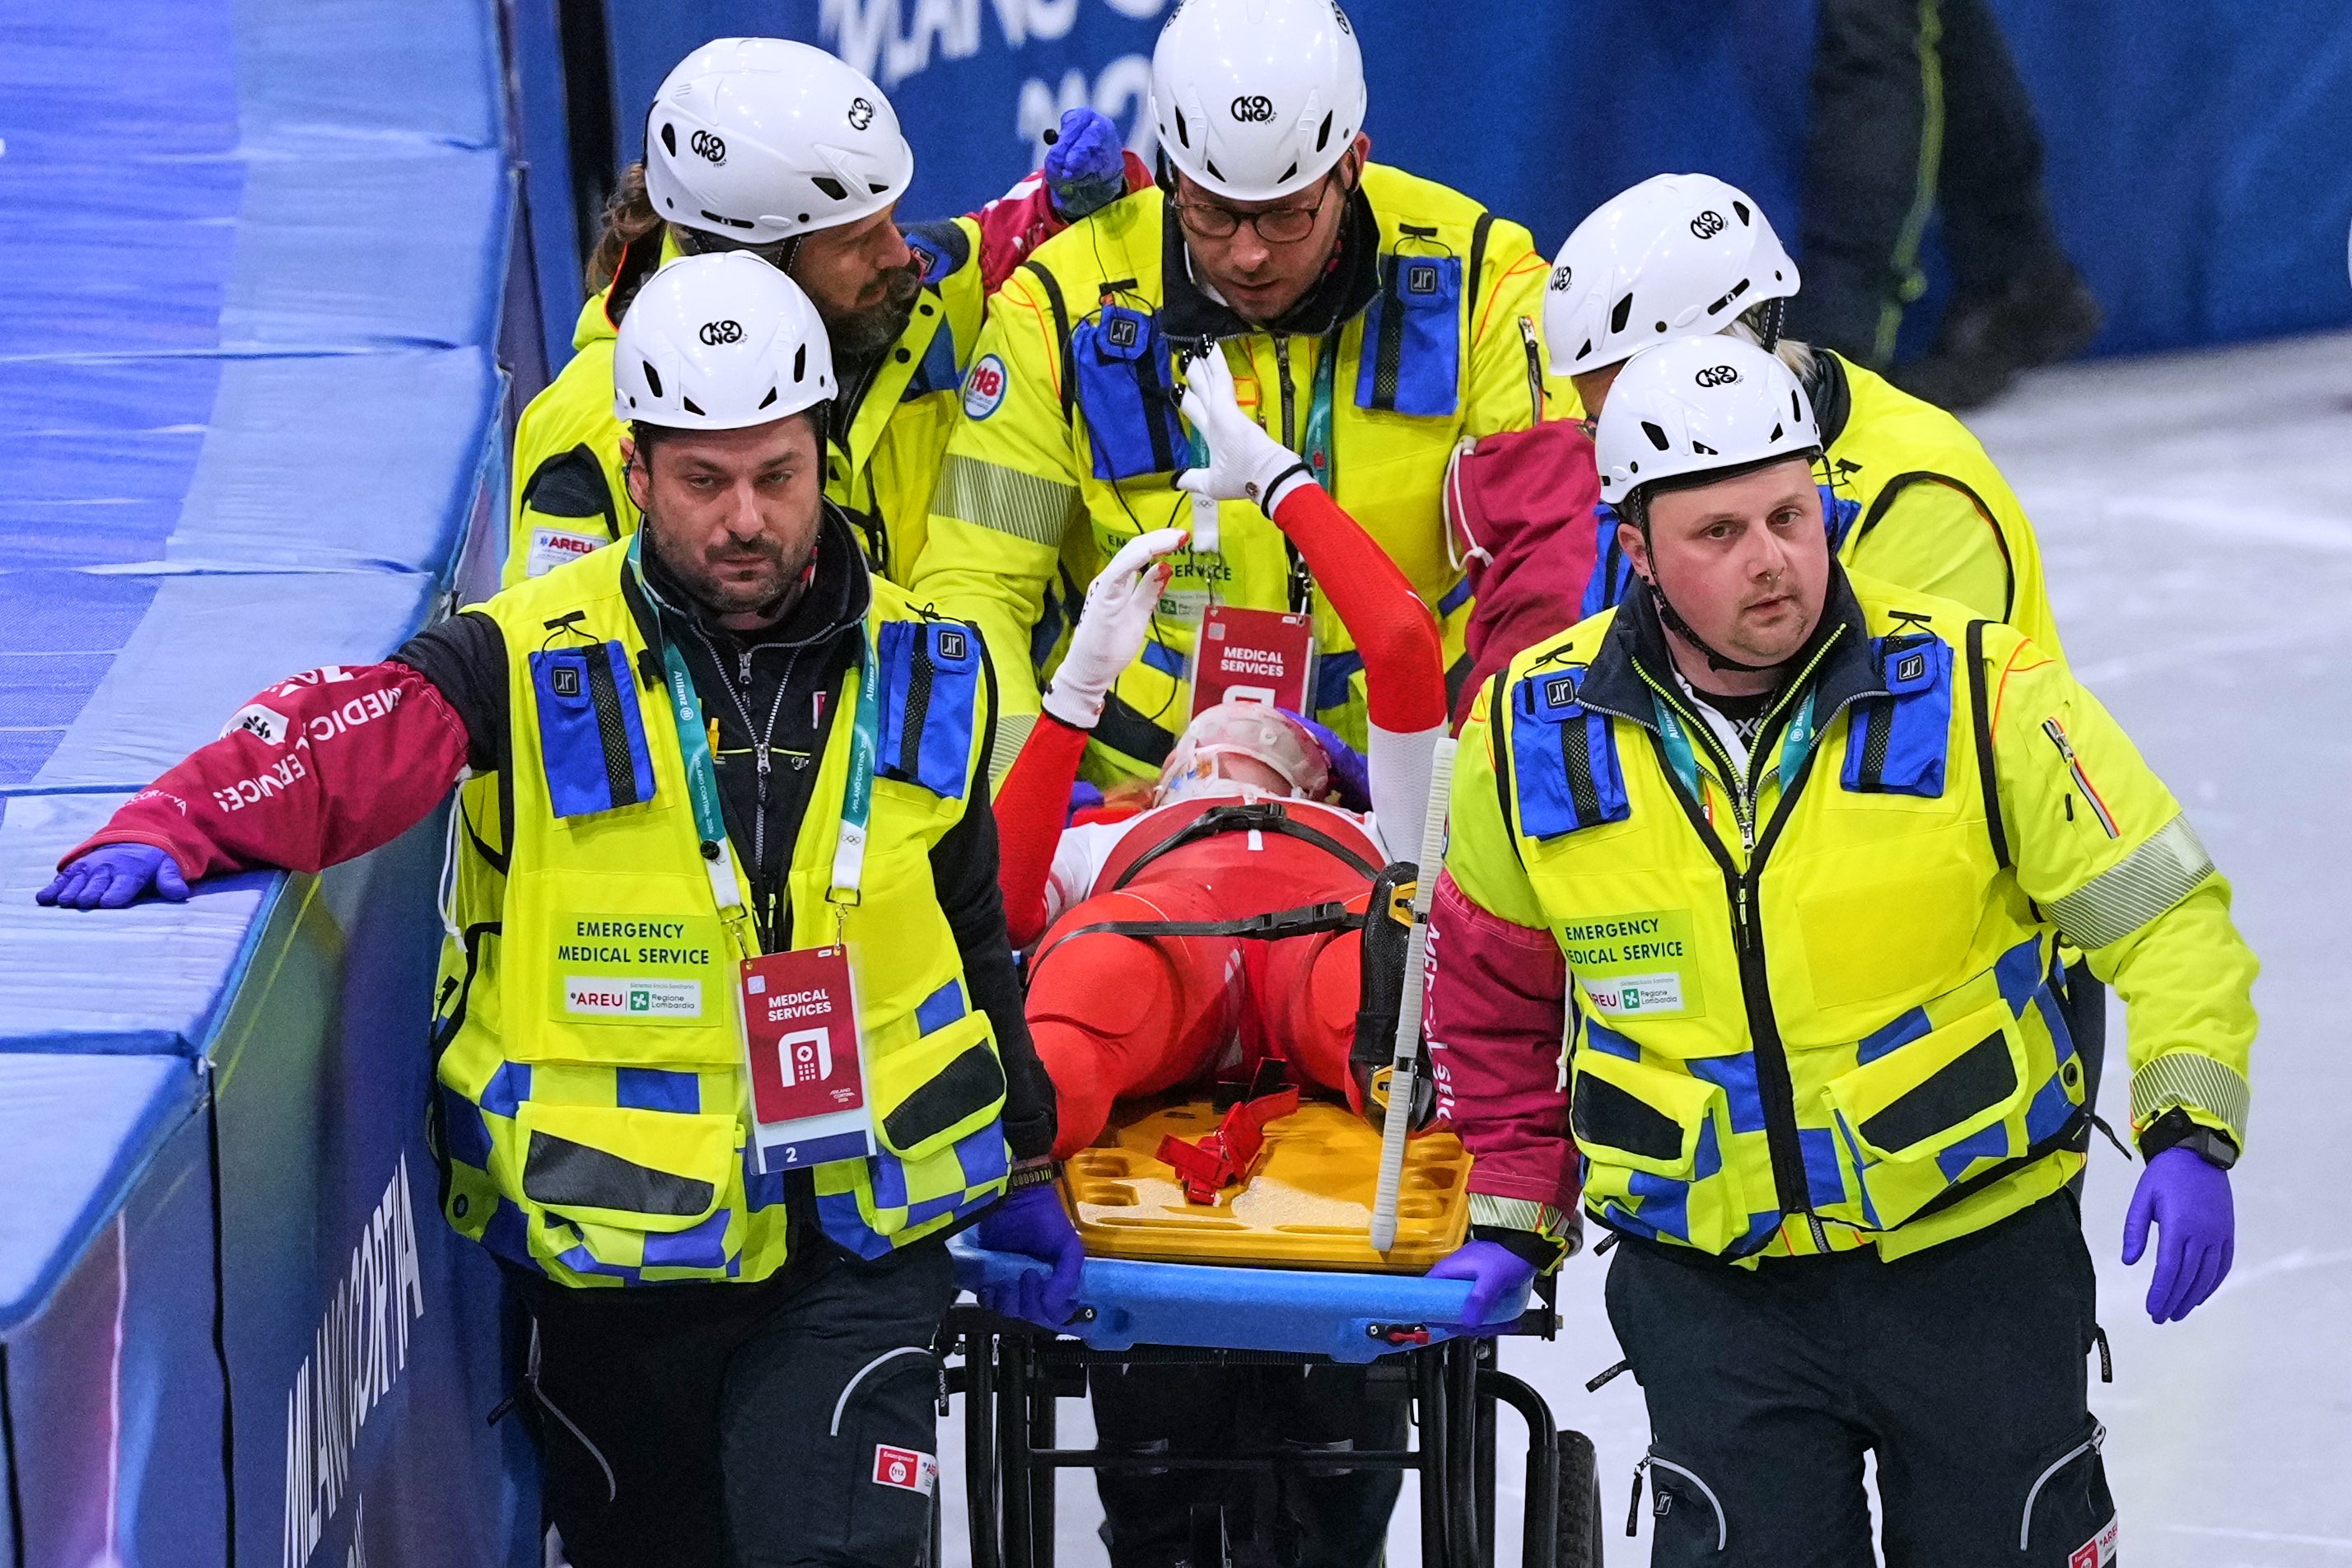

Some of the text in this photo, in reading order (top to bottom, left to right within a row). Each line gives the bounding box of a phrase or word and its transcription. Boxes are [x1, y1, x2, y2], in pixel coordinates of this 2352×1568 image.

[971, 366, 1000, 396] 118
[548, 537, 593, 553] AREU
[1175, 563, 1232, 581] ERVICE
[1223, 646, 1285, 665] MEDICAL
[1220, 659, 1285, 678] SERVICES
[674, 670, 688, 707] Allianz
[577, 922, 684, 939] EMERGENCY
[1566, 918, 1659, 940] EMERGENCY
[558, 945, 709, 964] MEDICAL SERVICE
[1623, 941, 1683, 961] SERVICE
[576, 992, 623, 1007] AREU
[652, 994, 684, 1003] Regione
[768, 988, 829, 1009] MEDICAL
[1589, 992, 1617, 1007] REU
[768, 1001, 833, 1022] SERVICES
[785, 1147, 797, 1164] 2
